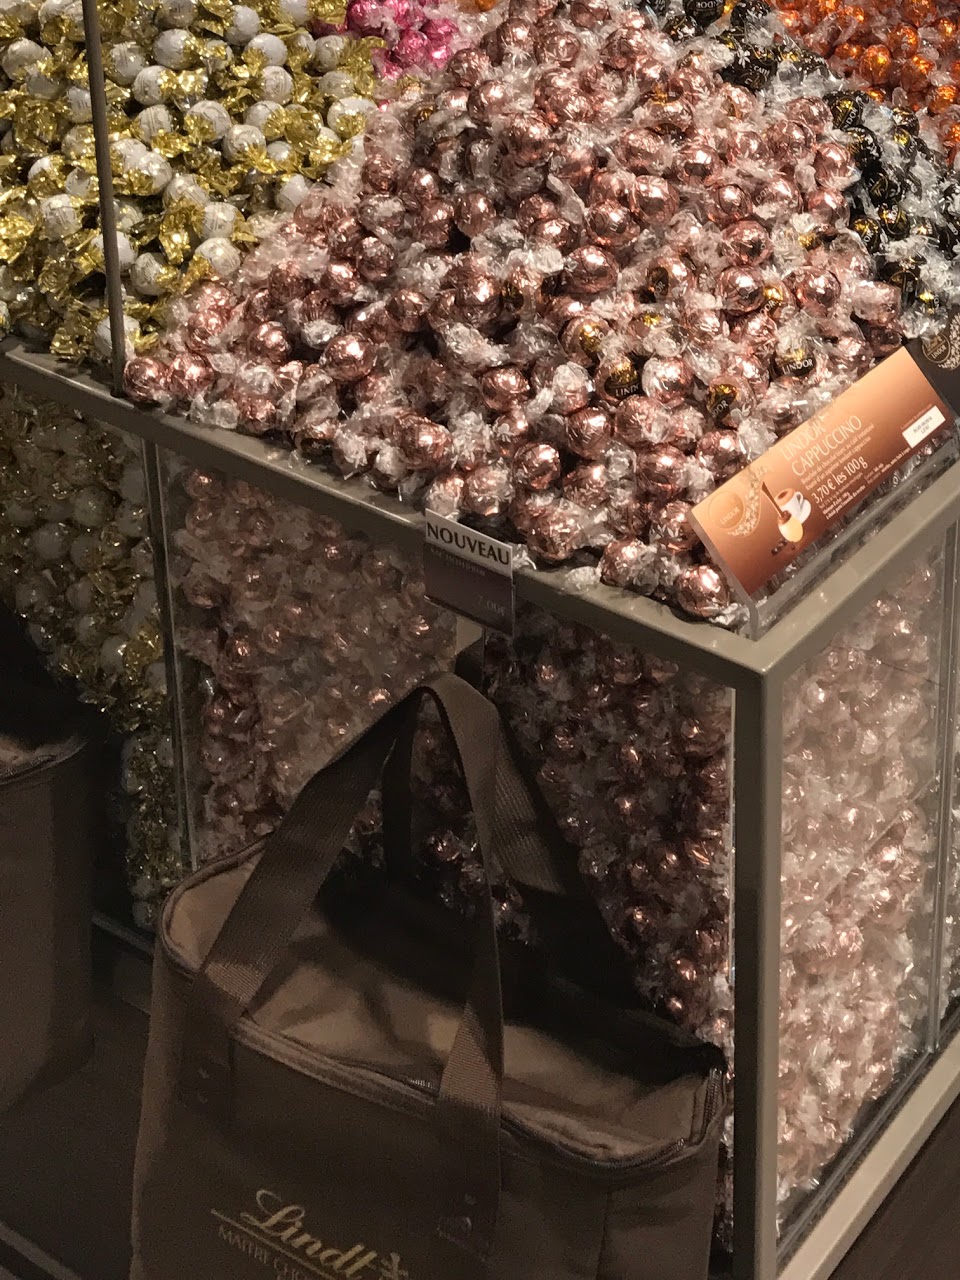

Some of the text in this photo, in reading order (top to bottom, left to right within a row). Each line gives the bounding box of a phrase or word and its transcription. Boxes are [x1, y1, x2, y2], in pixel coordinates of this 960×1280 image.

[782, 358, 813, 376] LINDOR
[780, 419, 827, 461] LINDOR
[791, 415, 863, 477] CAPPUCCINO
[832, 472, 847, 486] les
[427, 522, 509, 565] NOUVEAU
[240, 1189, 378, 1278] Lindt
